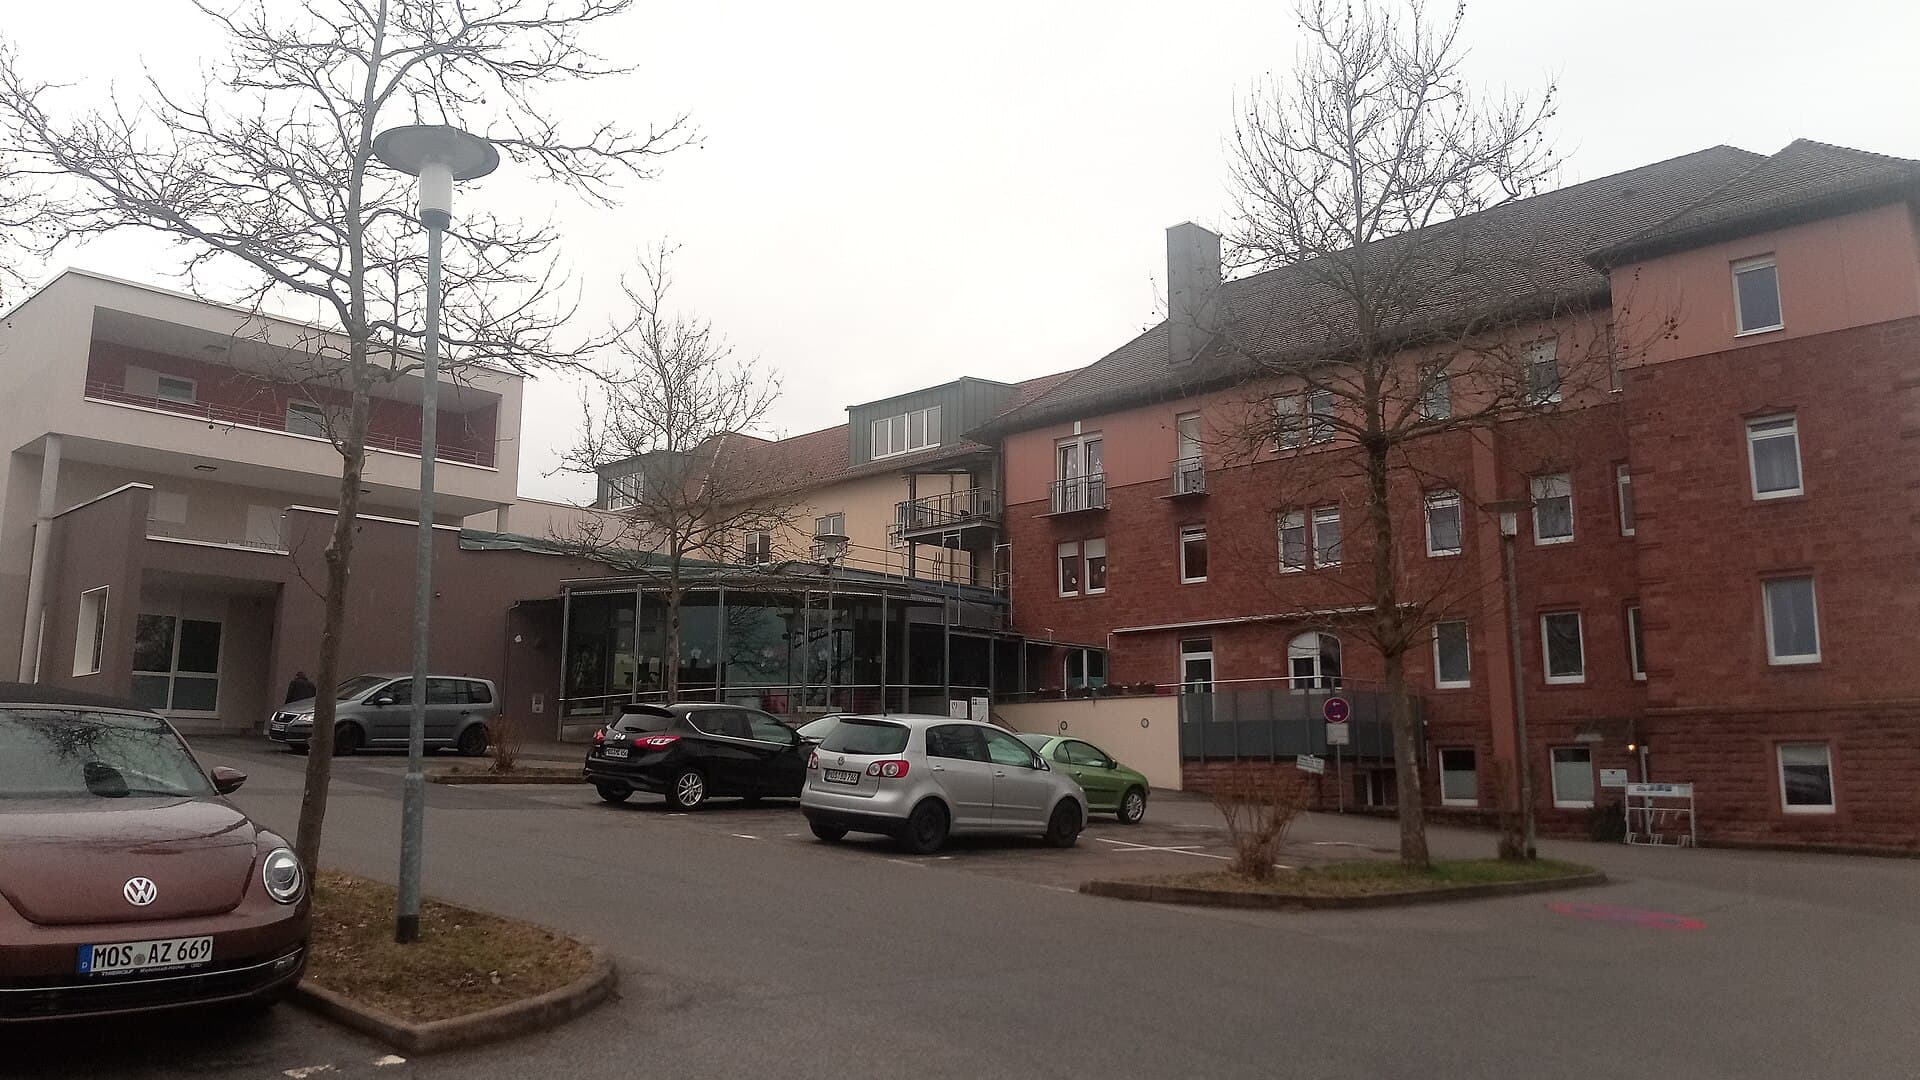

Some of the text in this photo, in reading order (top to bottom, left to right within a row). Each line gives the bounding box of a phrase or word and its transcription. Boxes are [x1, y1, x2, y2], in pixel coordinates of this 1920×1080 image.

[93, 945, 133, 968] MOS
[148, 943, 172, 964] AZ
[177, 939, 211, 961] 669
